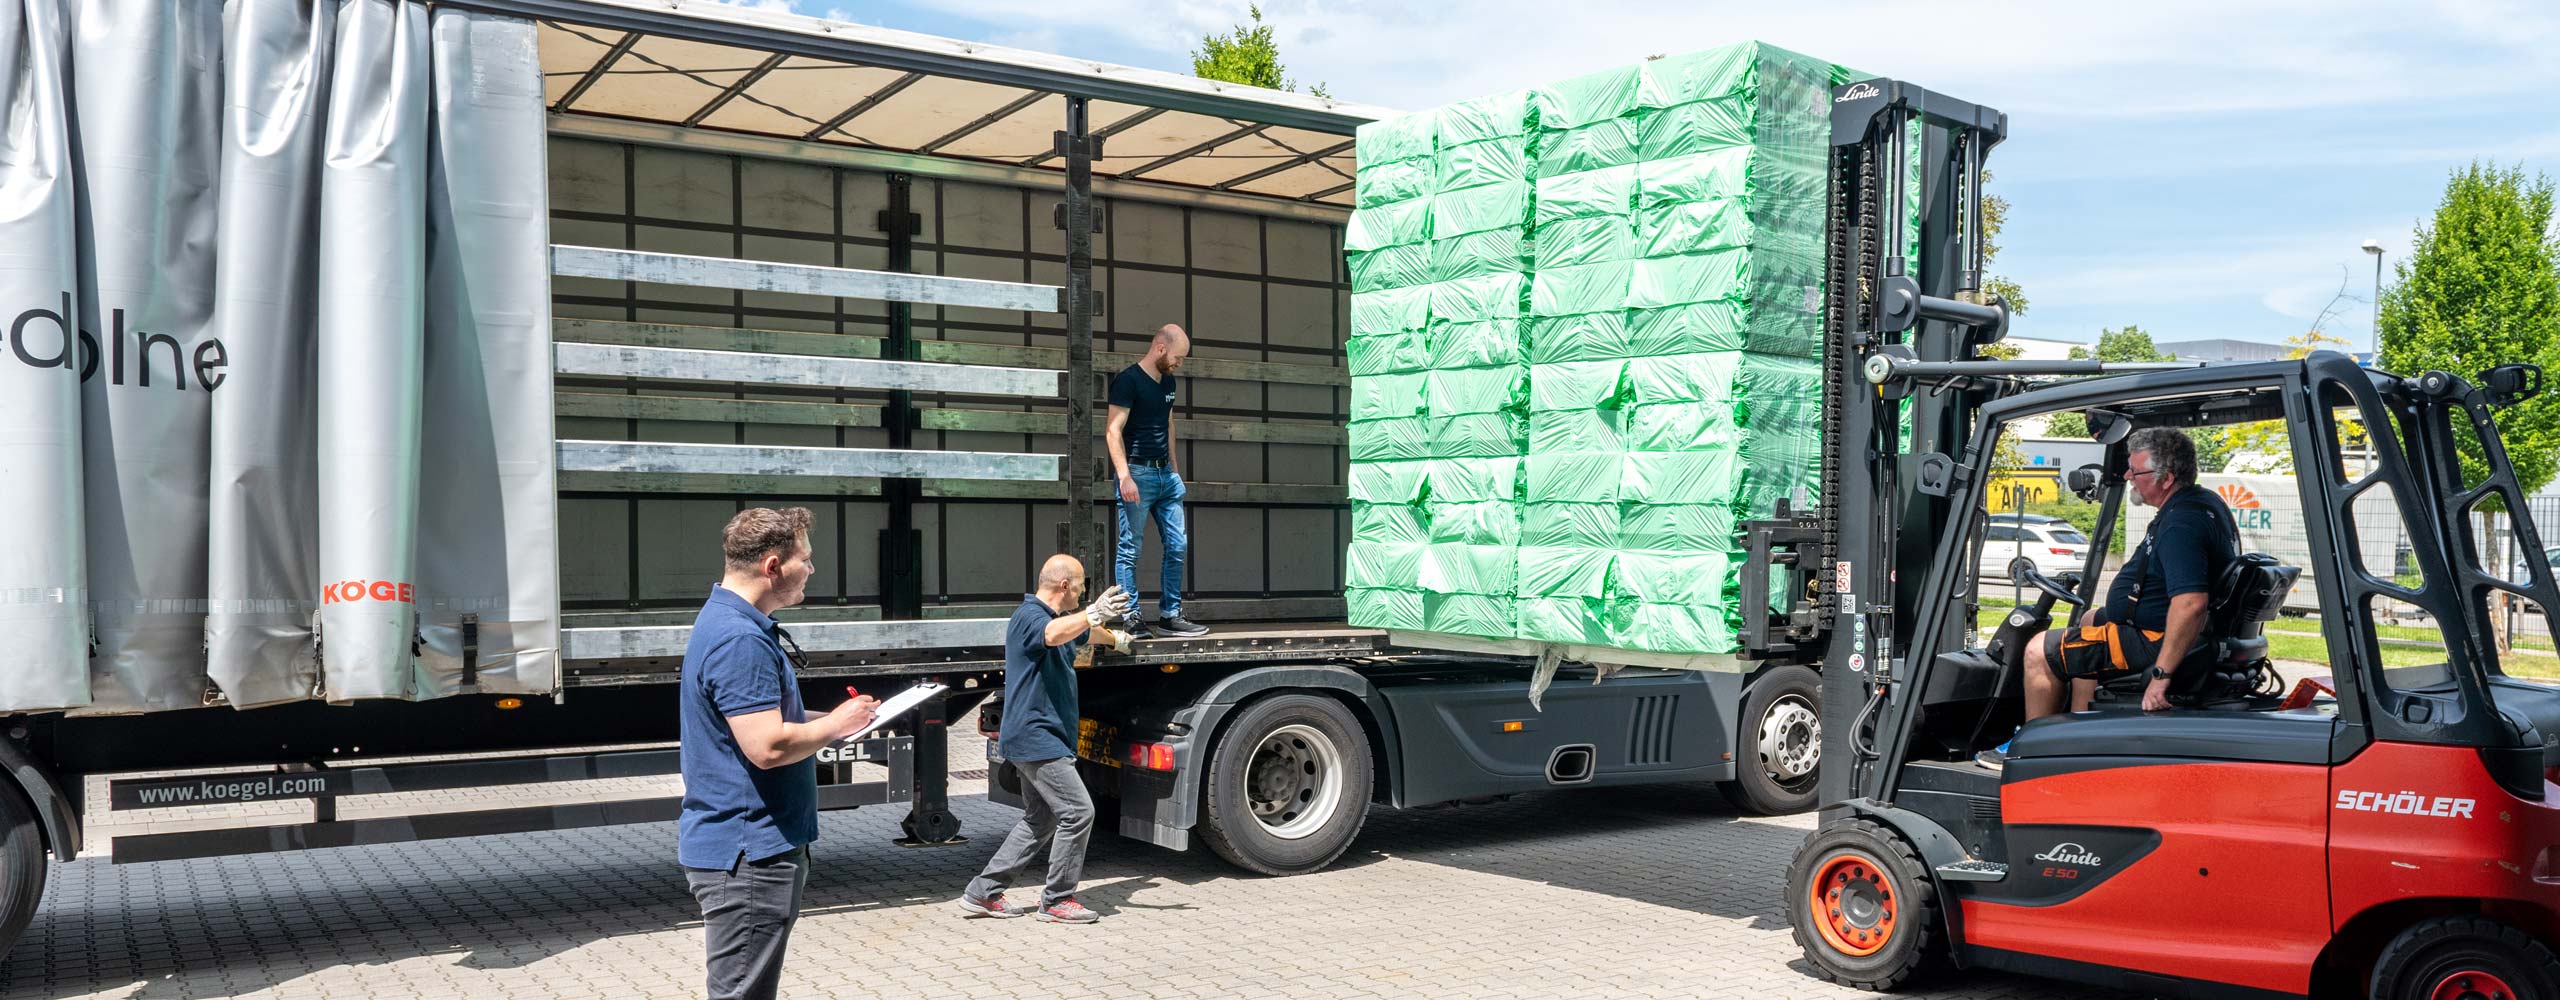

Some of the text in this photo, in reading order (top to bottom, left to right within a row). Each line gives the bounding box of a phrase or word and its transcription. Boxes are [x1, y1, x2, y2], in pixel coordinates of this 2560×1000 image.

[1835, 83, 1880, 102] Linde
[816, 743, 871, 763] GEL
[139, 777, 326, 804] www.koegel.com
[2335, 789, 2476, 819] SCHÖLER
[2035, 842, 2101, 867] Linde
[2042, 867, 2079, 879] E 50
